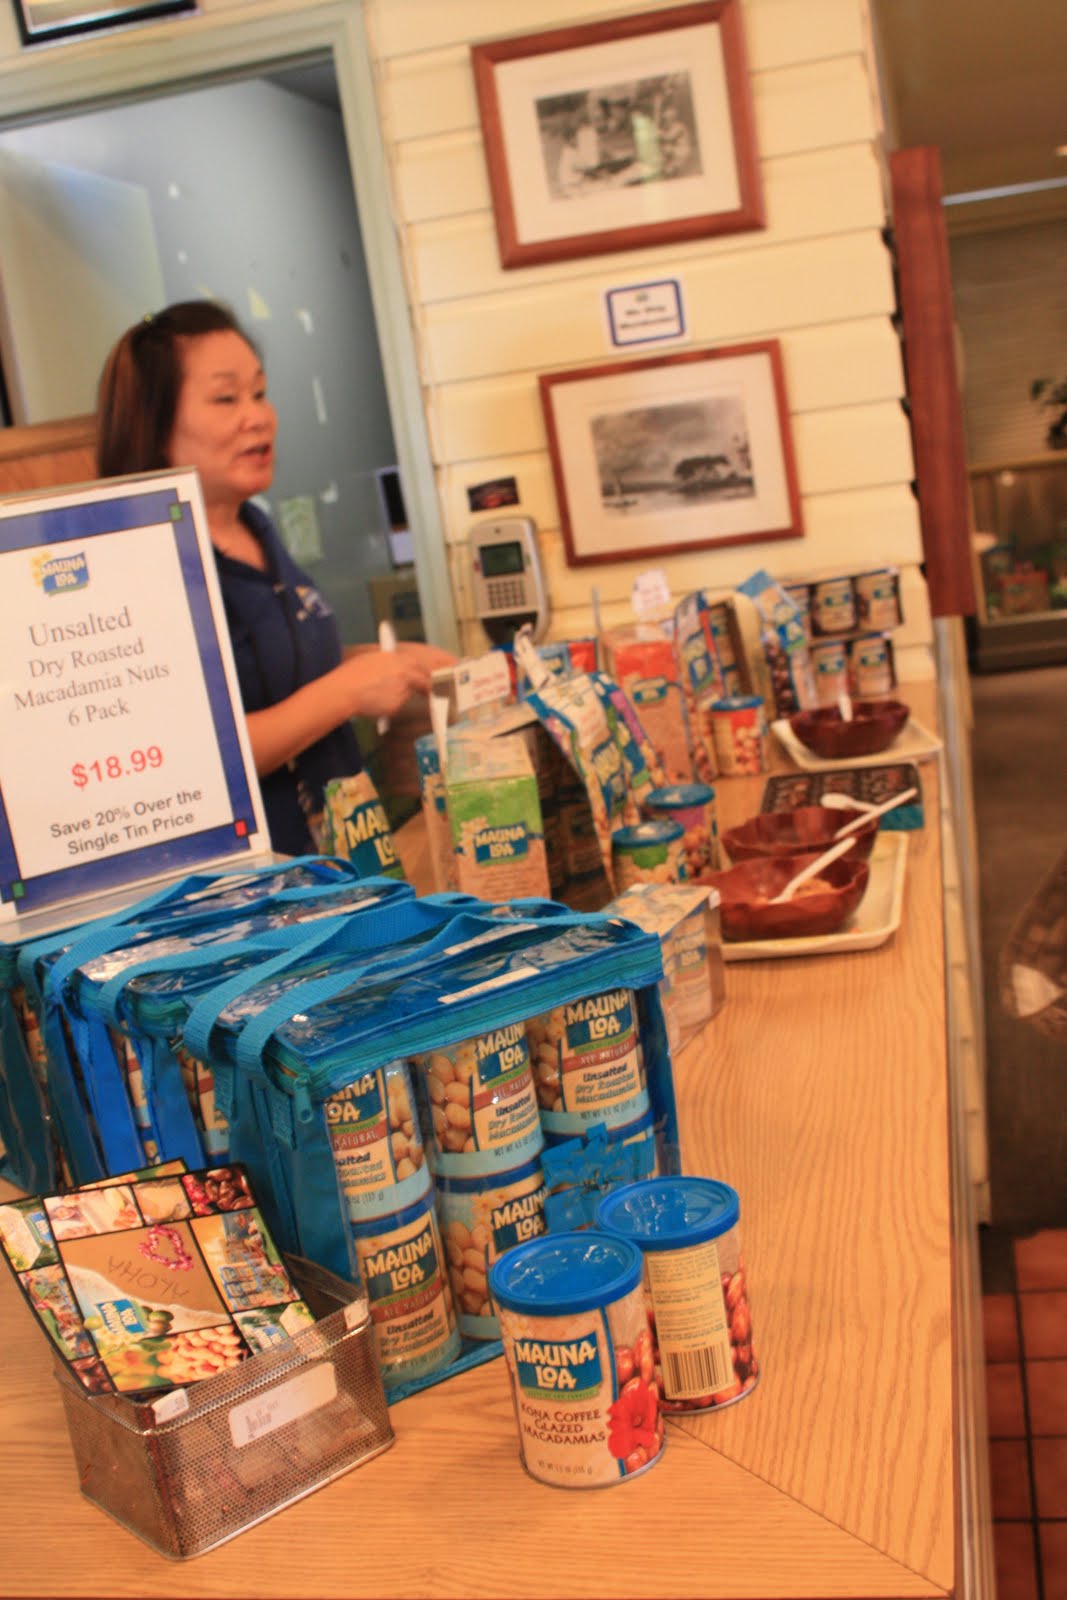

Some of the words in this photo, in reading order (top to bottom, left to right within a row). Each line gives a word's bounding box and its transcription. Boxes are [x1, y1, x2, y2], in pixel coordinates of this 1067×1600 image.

[29, 606, 132, 647] Unsalted
[29, 658, 65, 679] Dry
[71, 637, 145, 669] Roasted
[14, 672, 122, 711] Macadamia
[127, 662, 171, 685] Nuts
[68, 708, 80, 726] 6
[86, 698, 130, 722] Pack
[71, 745, 163, 791] $18.99
[50, 818, 91, 838] Save
[95, 806, 130, 827] 20%
[133, 797, 172, 816] Over
[176, 789, 202, 805] the
[67, 831, 119, 855] Single
[122, 822, 149, 840] Tin
[152, 812, 195, 832] Price
[566, 988, 630, 1025] MAUNA
[588, 1014, 622, 1040] LOA
[498, 1044, 524, 1072] LOA
[583, 1062, 628, 1082] Unsalted
[495, 1093, 532, 1118] Unsalted
[365, 1231, 432, 1279] MAUNA
[106, 1255, 191, 1298] ALOHA
[389, 1263, 425, 1292] LOA
[386, 1309, 434, 1335] Unsalted
[514, 1339, 598, 1368] MAUNA
[534, 1365, 578, 1390] LOA
[520, 1402, 550, 1420] KONA
[553, 1408, 602, 1423] COFFEE
[534, 1418, 584, 1433] GLAZED
[523, 1422, 606, 1445] MACADAMIAS
